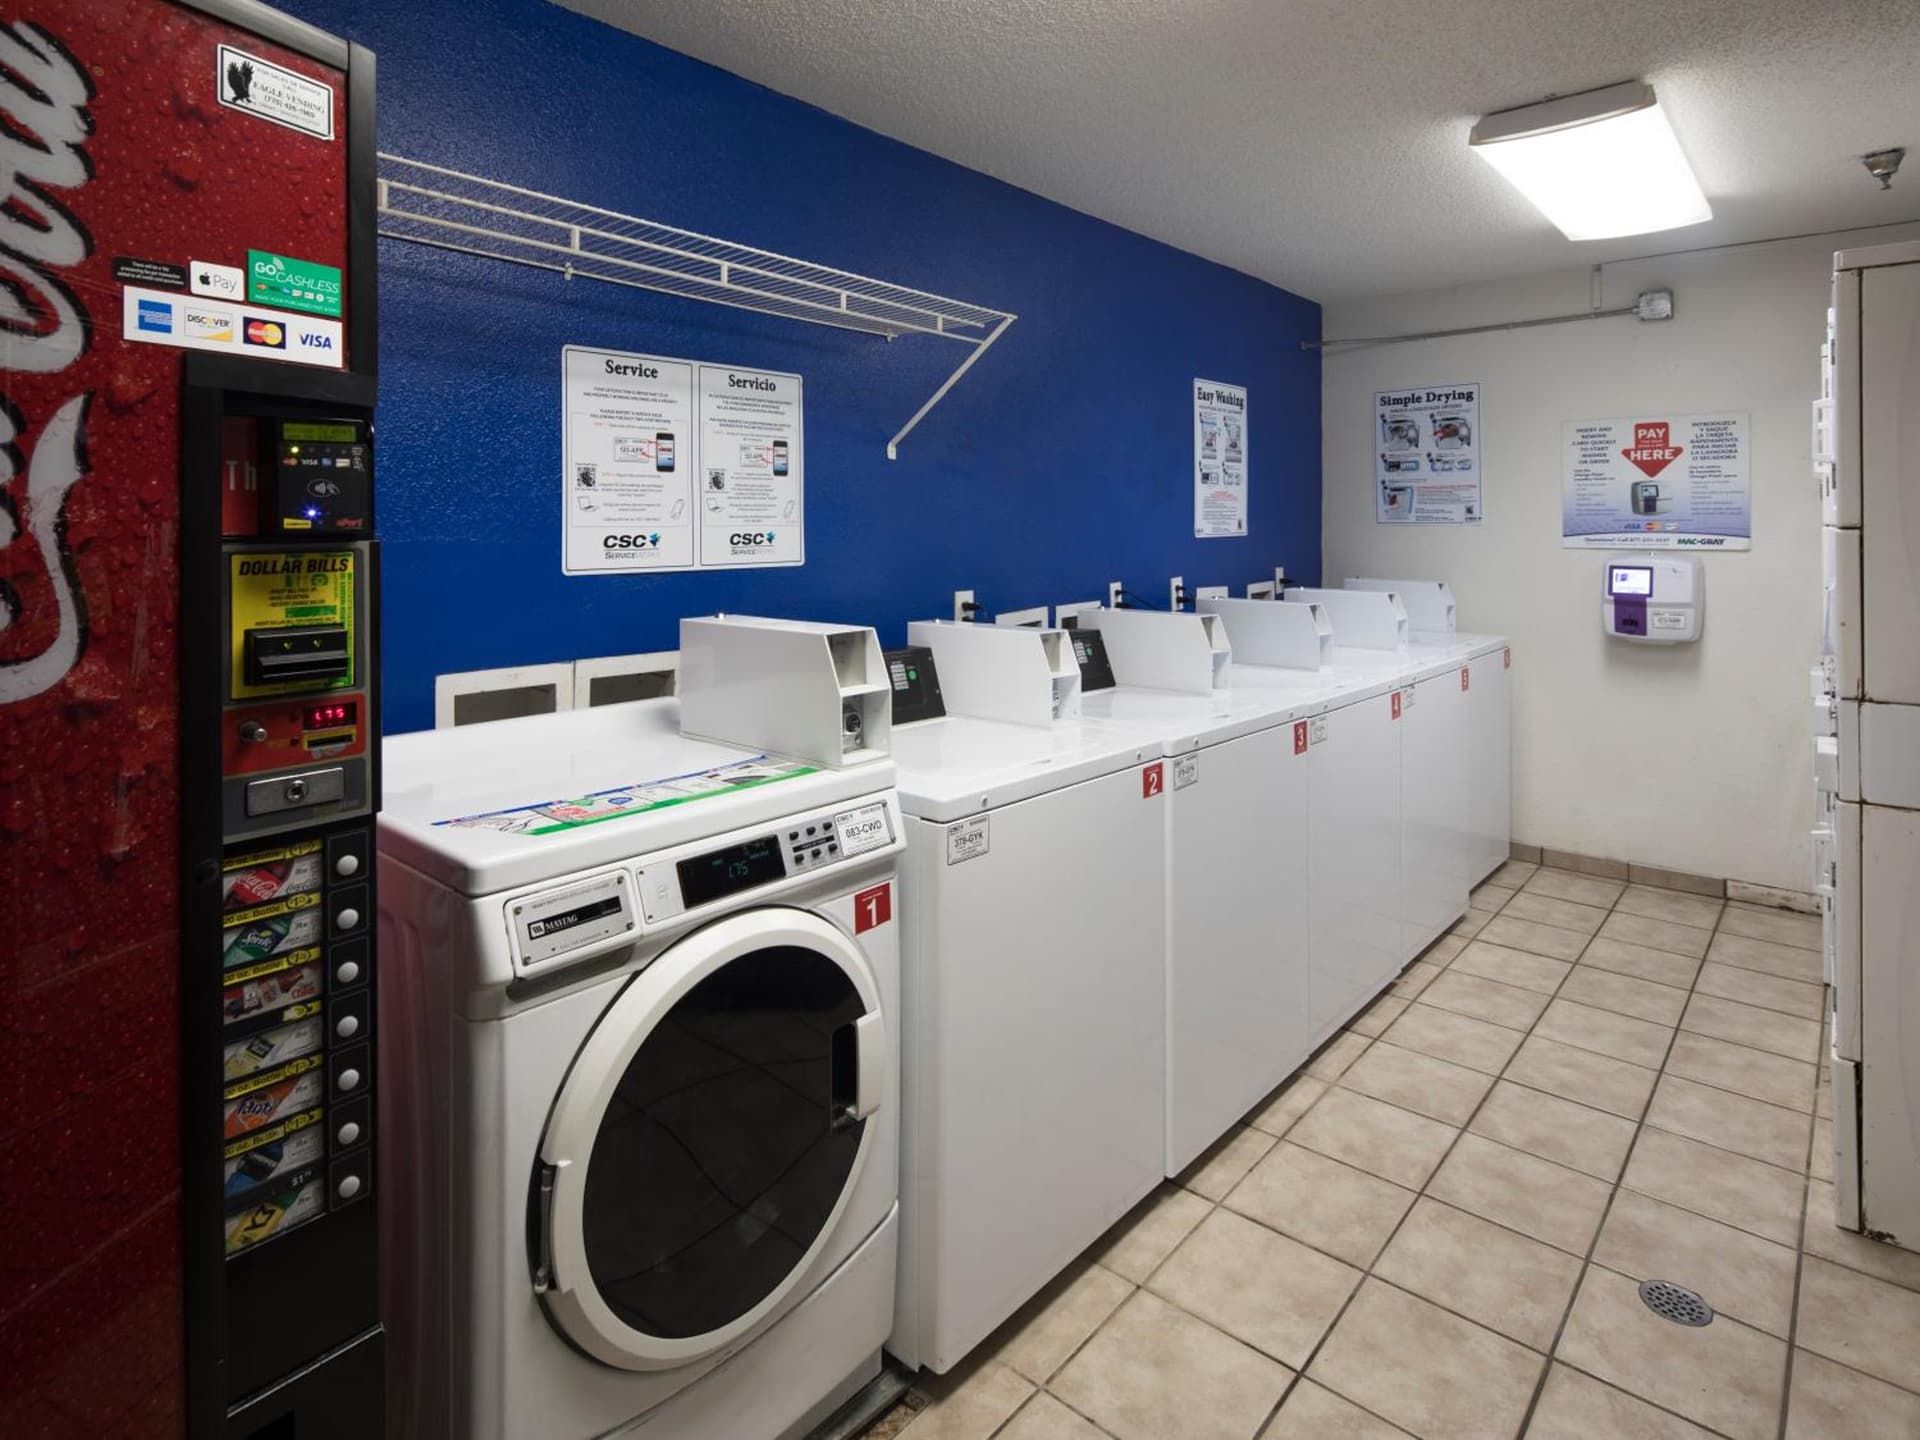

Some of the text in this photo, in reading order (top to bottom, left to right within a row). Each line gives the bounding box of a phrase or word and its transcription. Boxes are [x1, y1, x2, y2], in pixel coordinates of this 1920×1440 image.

[253, 81, 325, 114] EAGLE VENDING
[255, 262, 277, 275] GO
[214, 275, 237, 293] Pay
[276, 272, 338, 294] CASHLESS
[187, 314, 230, 327] DISCOVER
[300, 333, 332, 349] VISA
[605, 359, 658, 379] Service
[728, 373, 776, 392] Servicio
[1197, 387, 1214, 405] Easy
[1216, 391, 1244, 410] Washing
[1380, 390, 1474, 407] Simple Drying
[1637, 428, 1666, 439] PAY
[1630, 449, 1675, 461] HERE
[603, 534, 647, 549] CSC
[729, 533, 765, 546] CSC
[239, 559, 349, 576] DOLLAR BILLS
[1297, 727, 1304, 747] 3
[1150, 772, 1158, 795] 2
[252, 905, 281, 916] Bottle
[866, 896, 877, 928] 1
[544, 913, 578, 932] MAYTAG
